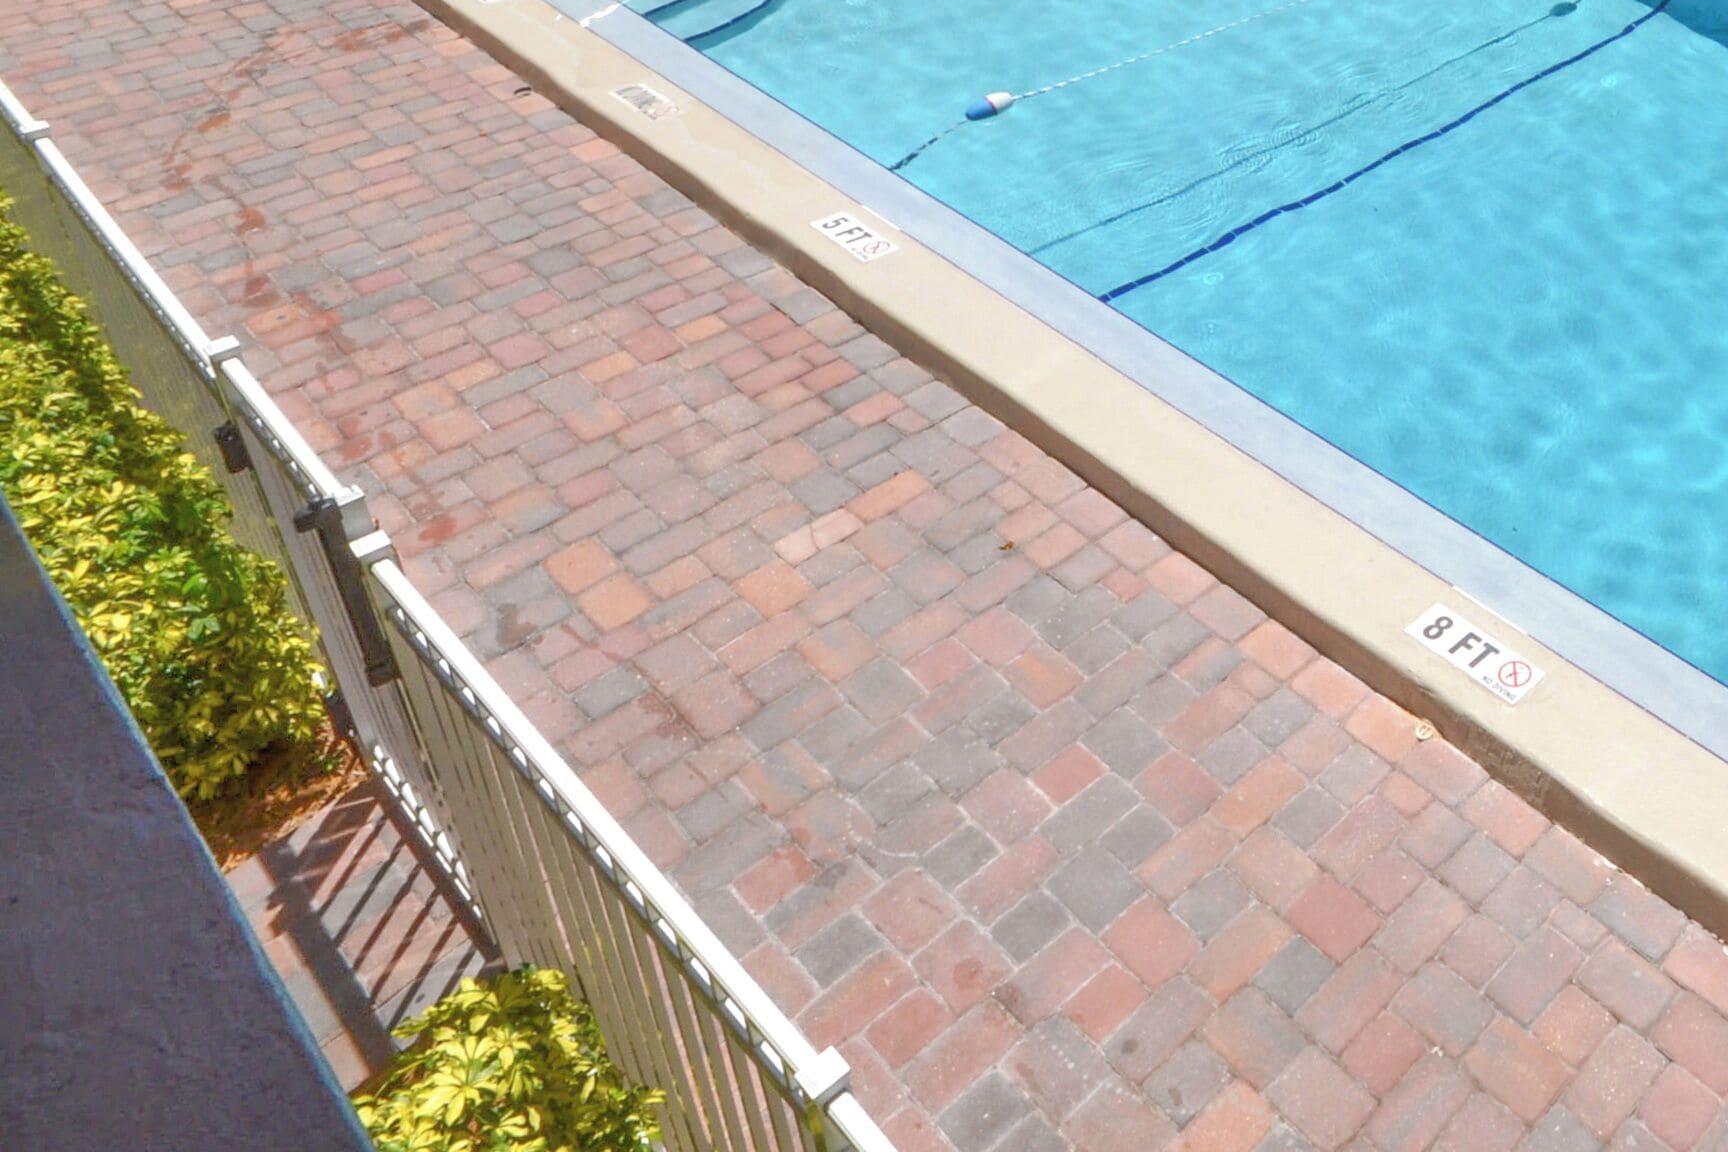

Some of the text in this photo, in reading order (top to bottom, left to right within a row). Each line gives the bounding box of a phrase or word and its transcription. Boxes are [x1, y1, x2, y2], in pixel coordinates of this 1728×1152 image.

[822, 216, 874, 244] 5 FT
[1422, 616, 1500, 669] 8 FT
